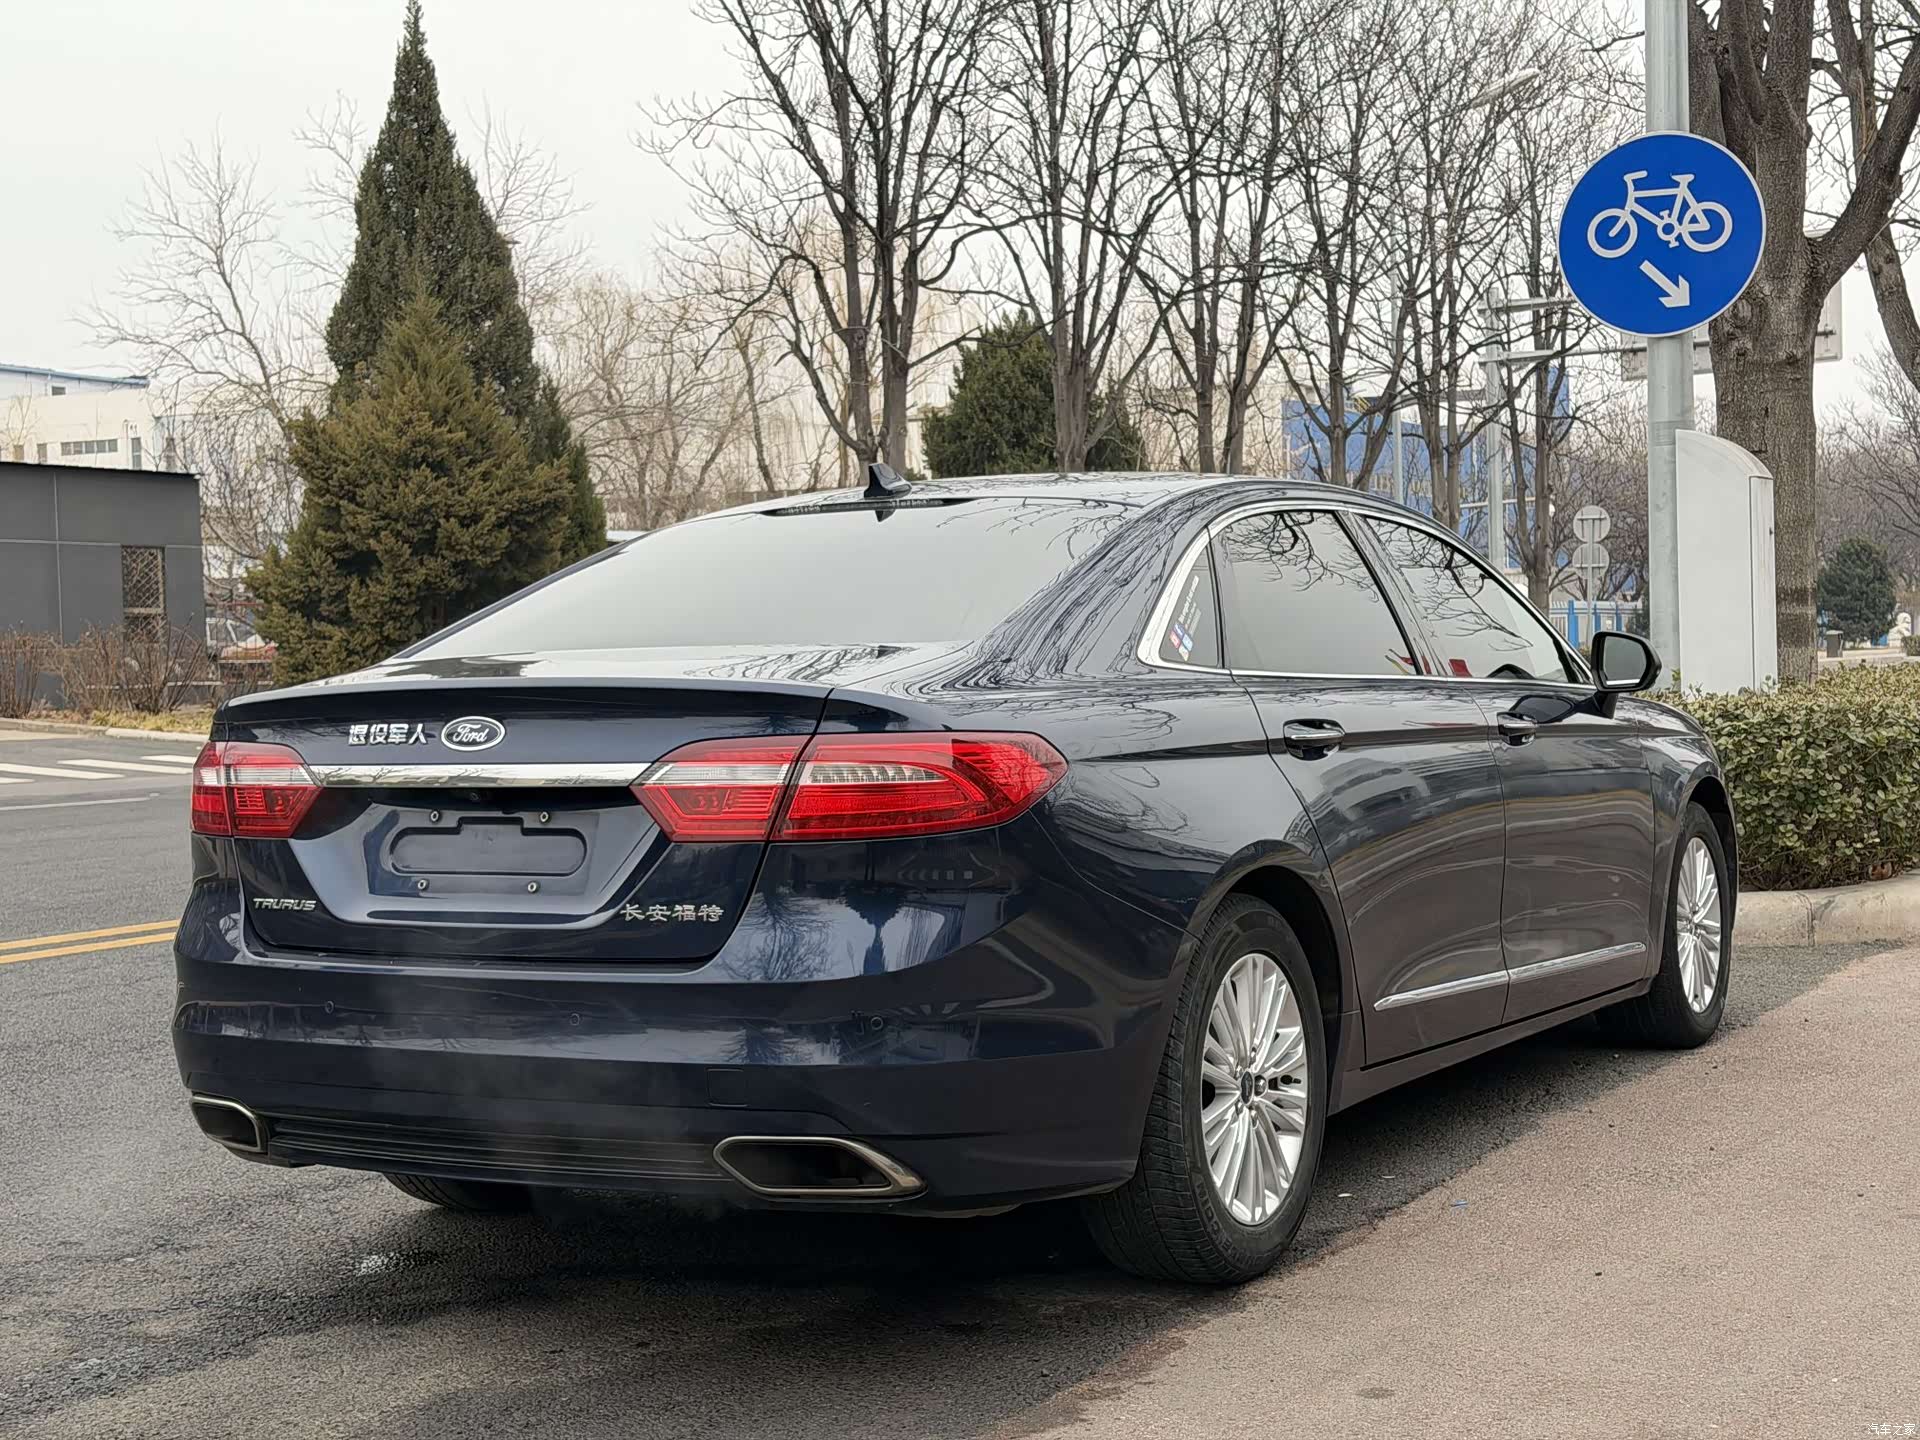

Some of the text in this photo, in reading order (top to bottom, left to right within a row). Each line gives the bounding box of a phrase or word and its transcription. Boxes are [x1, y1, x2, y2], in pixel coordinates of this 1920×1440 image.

[348, 723, 428, 745] 退役军人
[452, 723, 488, 743] Ford
[252, 898, 317, 911] TAURUS
[620, 904, 724, 921] 长安福特
